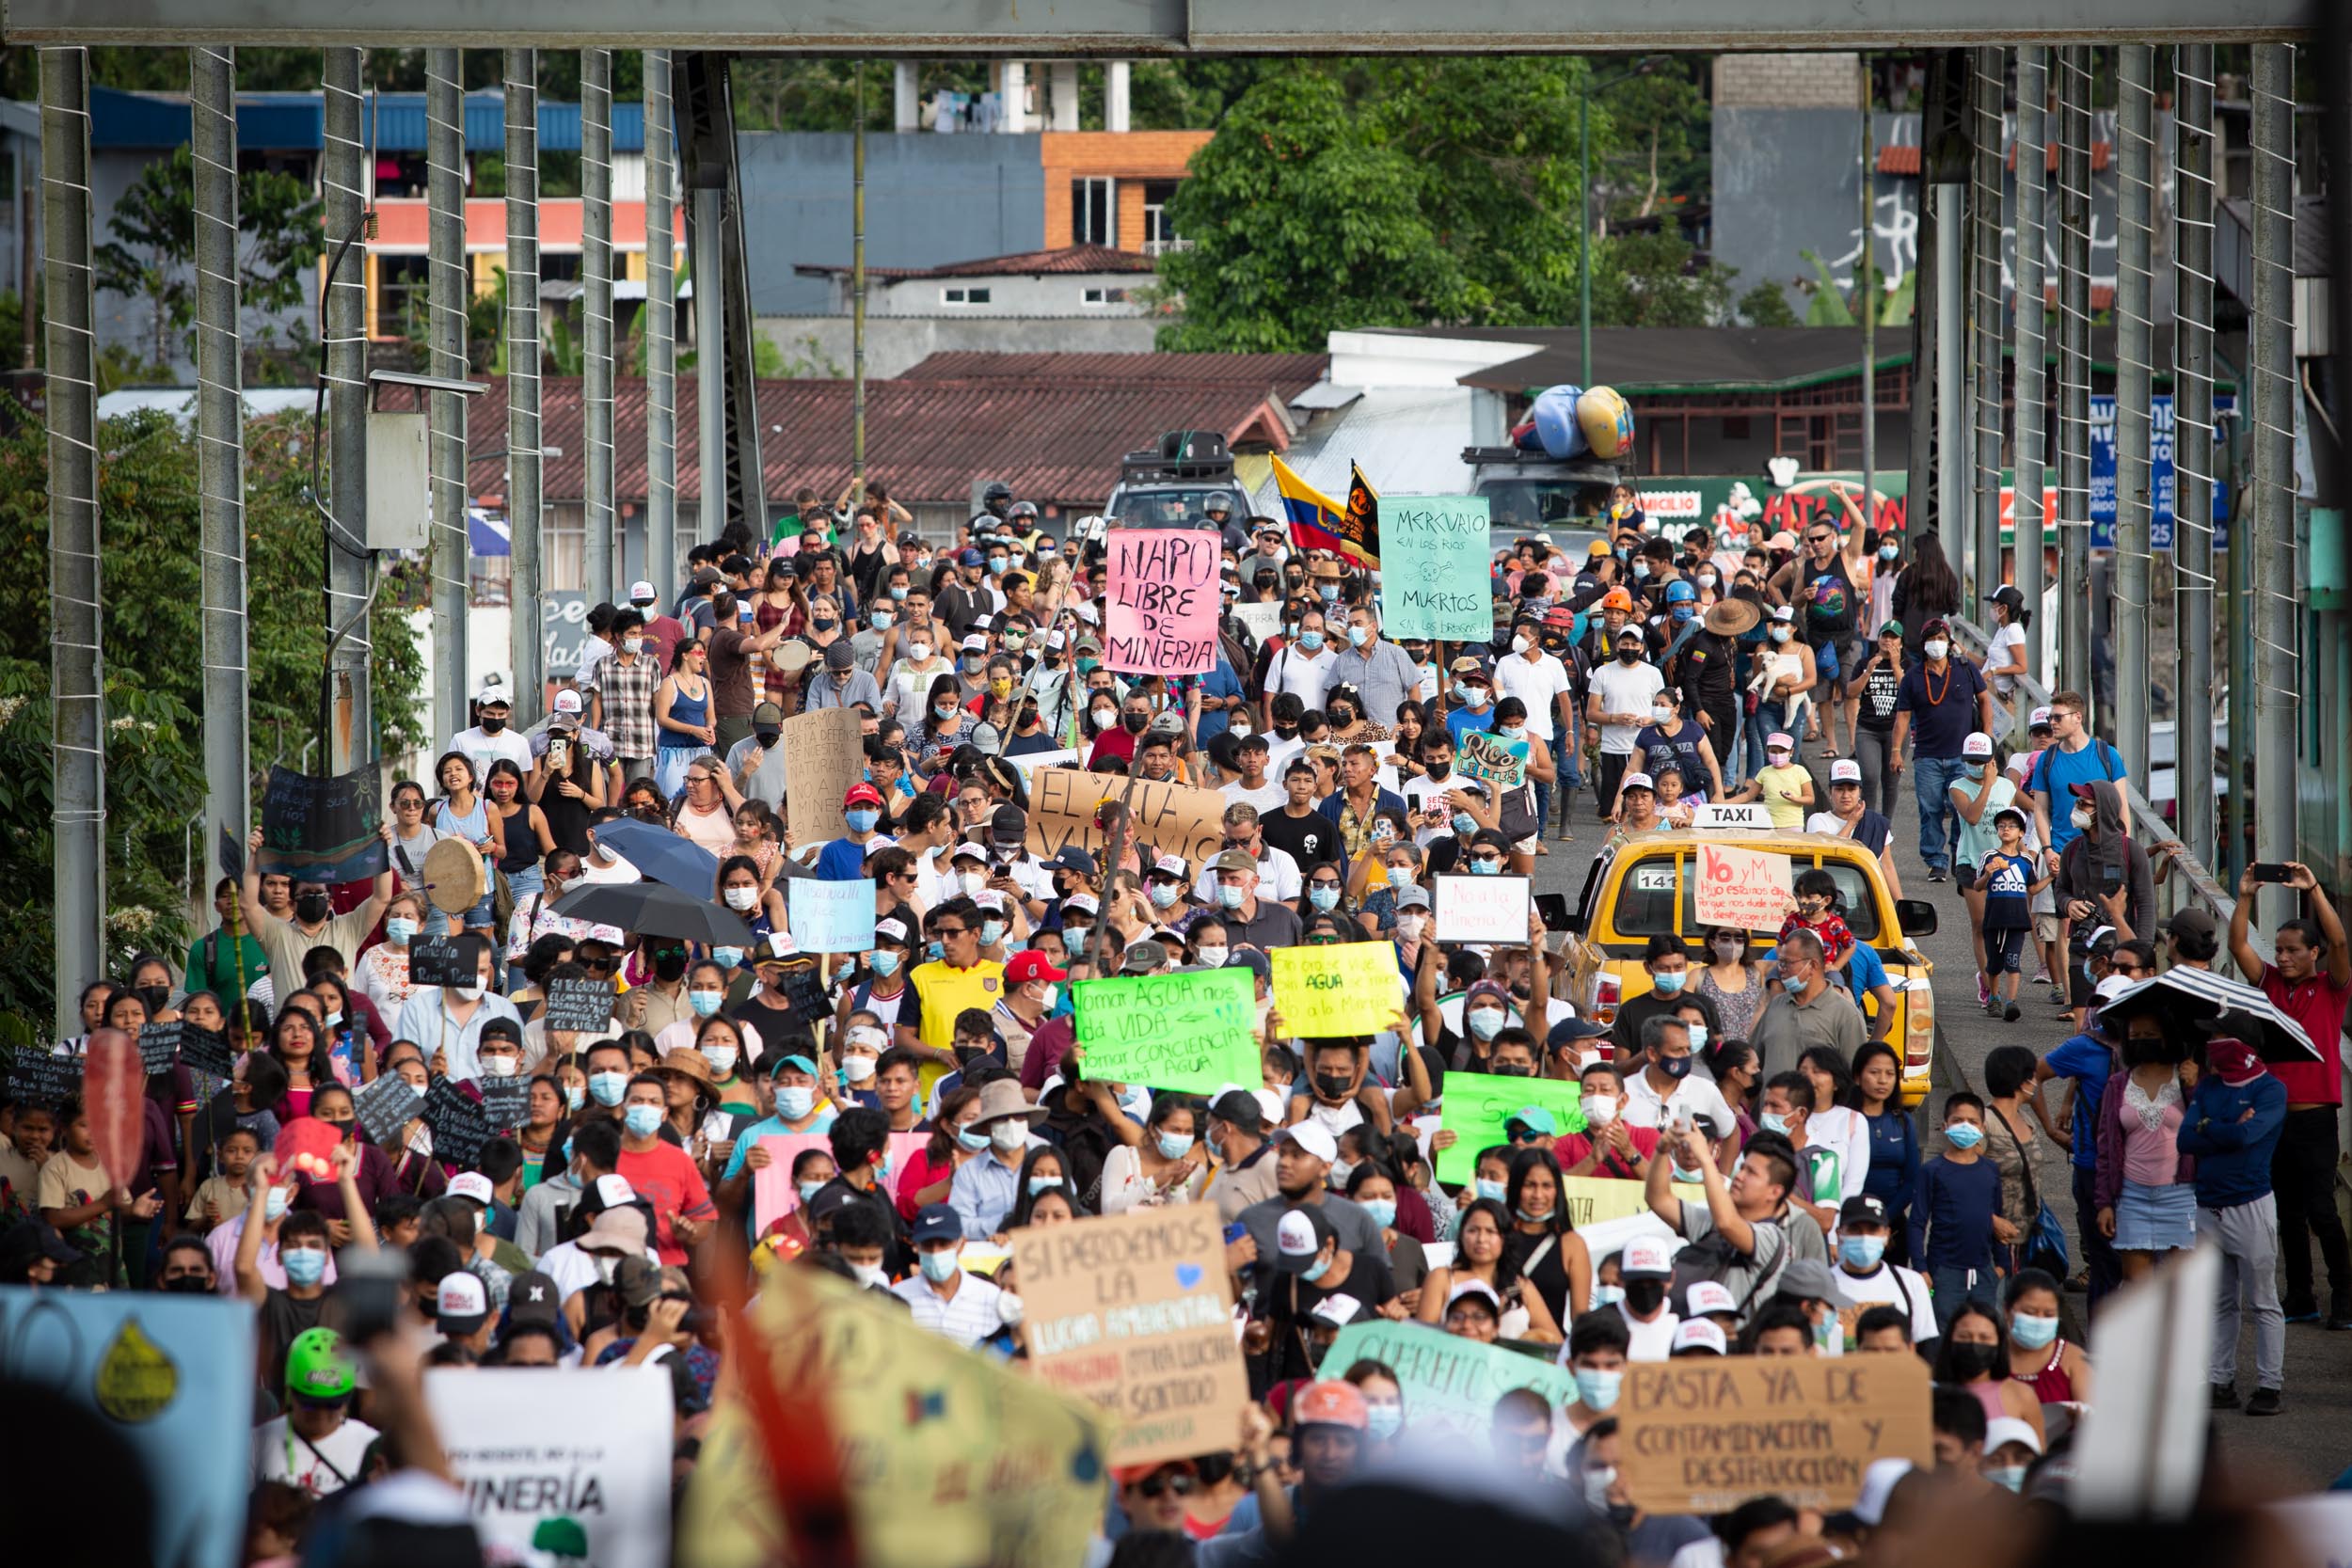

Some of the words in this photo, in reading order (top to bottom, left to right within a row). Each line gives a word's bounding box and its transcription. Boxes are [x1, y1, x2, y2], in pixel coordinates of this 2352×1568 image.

[1396, 510, 1486, 534] MERCURIO
[1397, 537, 1412, 547] EN
[1120, 537, 1213, 587] NAPO
[1117, 581, 1196, 617] LIBRE
[1143, 613, 1175, 638] DE
[1400, 618, 1414, 629] EN
[1108, 636, 1213, 669] MINERIA
[787, 710, 845, 733] LUCHAMOS
[795, 782, 812, 800] NO
[818, 778, 828, 796] A
[1041, 771, 1080, 817] EL
[798, 798, 844, 816] MINER
[1712, 808, 1753, 821] TAXI
[812, 816, 821, 832] A
[1073, 981, 1128, 1012] Tomar
[1135, 979, 1197, 1008] AGUA
[1203, 986, 1239, 1002] nos
[1306, 974, 1343, 990] AGUA
[1083, 1017, 1105, 1041] dá
[1117, 1011, 1168, 1041] VIDA
[1082, 1045, 1128, 1069] Tomar
[1135, 1027, 1240, 1065] CONCIENCIA
[1165, 1055, 1213, 1076] AGUA
[1058, 1216, 1211, 1279] PERDEMOS
[1096, 1268, 1136, 1304] LA
[1629, 1366, 1741, 1410] BASTA
[1758, 1367, 1804, 1404] YA
[1825, 1366, 1868, 1404] DE
[1635, 1413, 1833, 1456] CONTAMINACIÓN
[1863, 1418, 1882, 1450] Y
[464, 1465, 607, 1513] INERÍA
